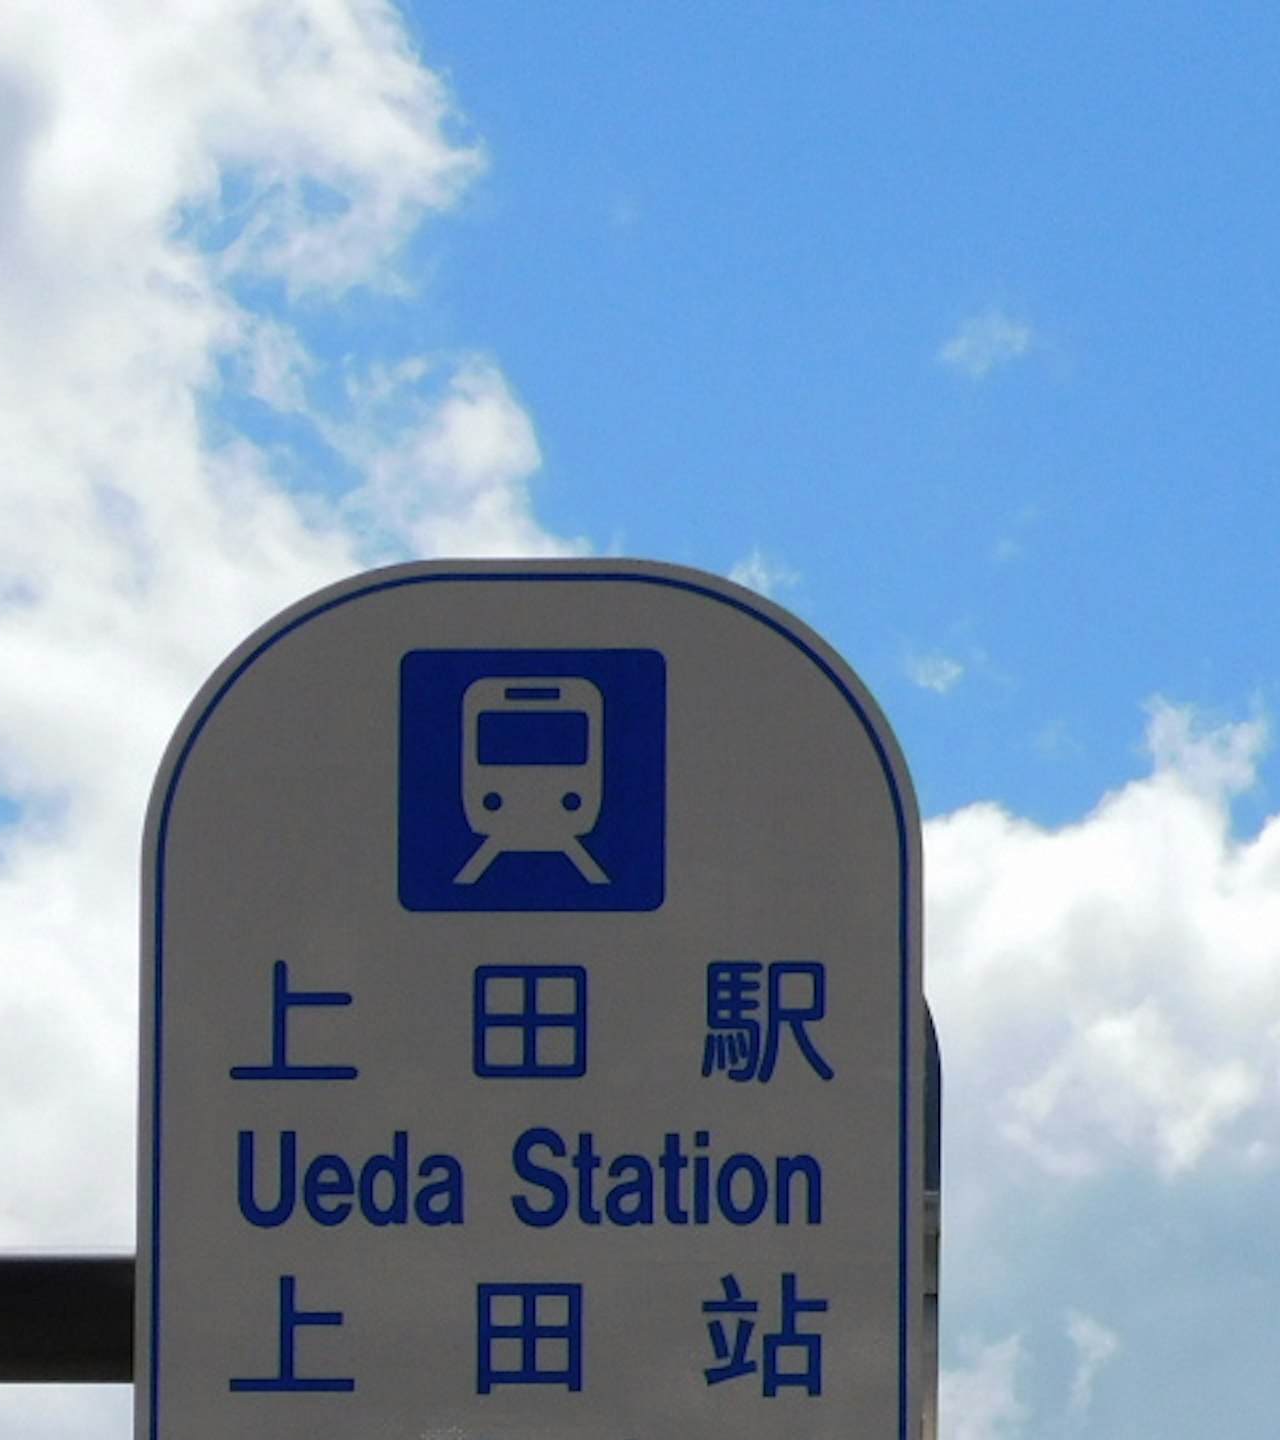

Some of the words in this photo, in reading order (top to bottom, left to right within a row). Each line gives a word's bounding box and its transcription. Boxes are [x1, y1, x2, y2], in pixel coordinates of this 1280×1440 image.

[230, 958, 836, 1084] 上田駅
[237, 1129, 465, 1229] Ueda
[511, 1126, 824, 1229] Station
[229, 1272, 829, 1398] 上田站
